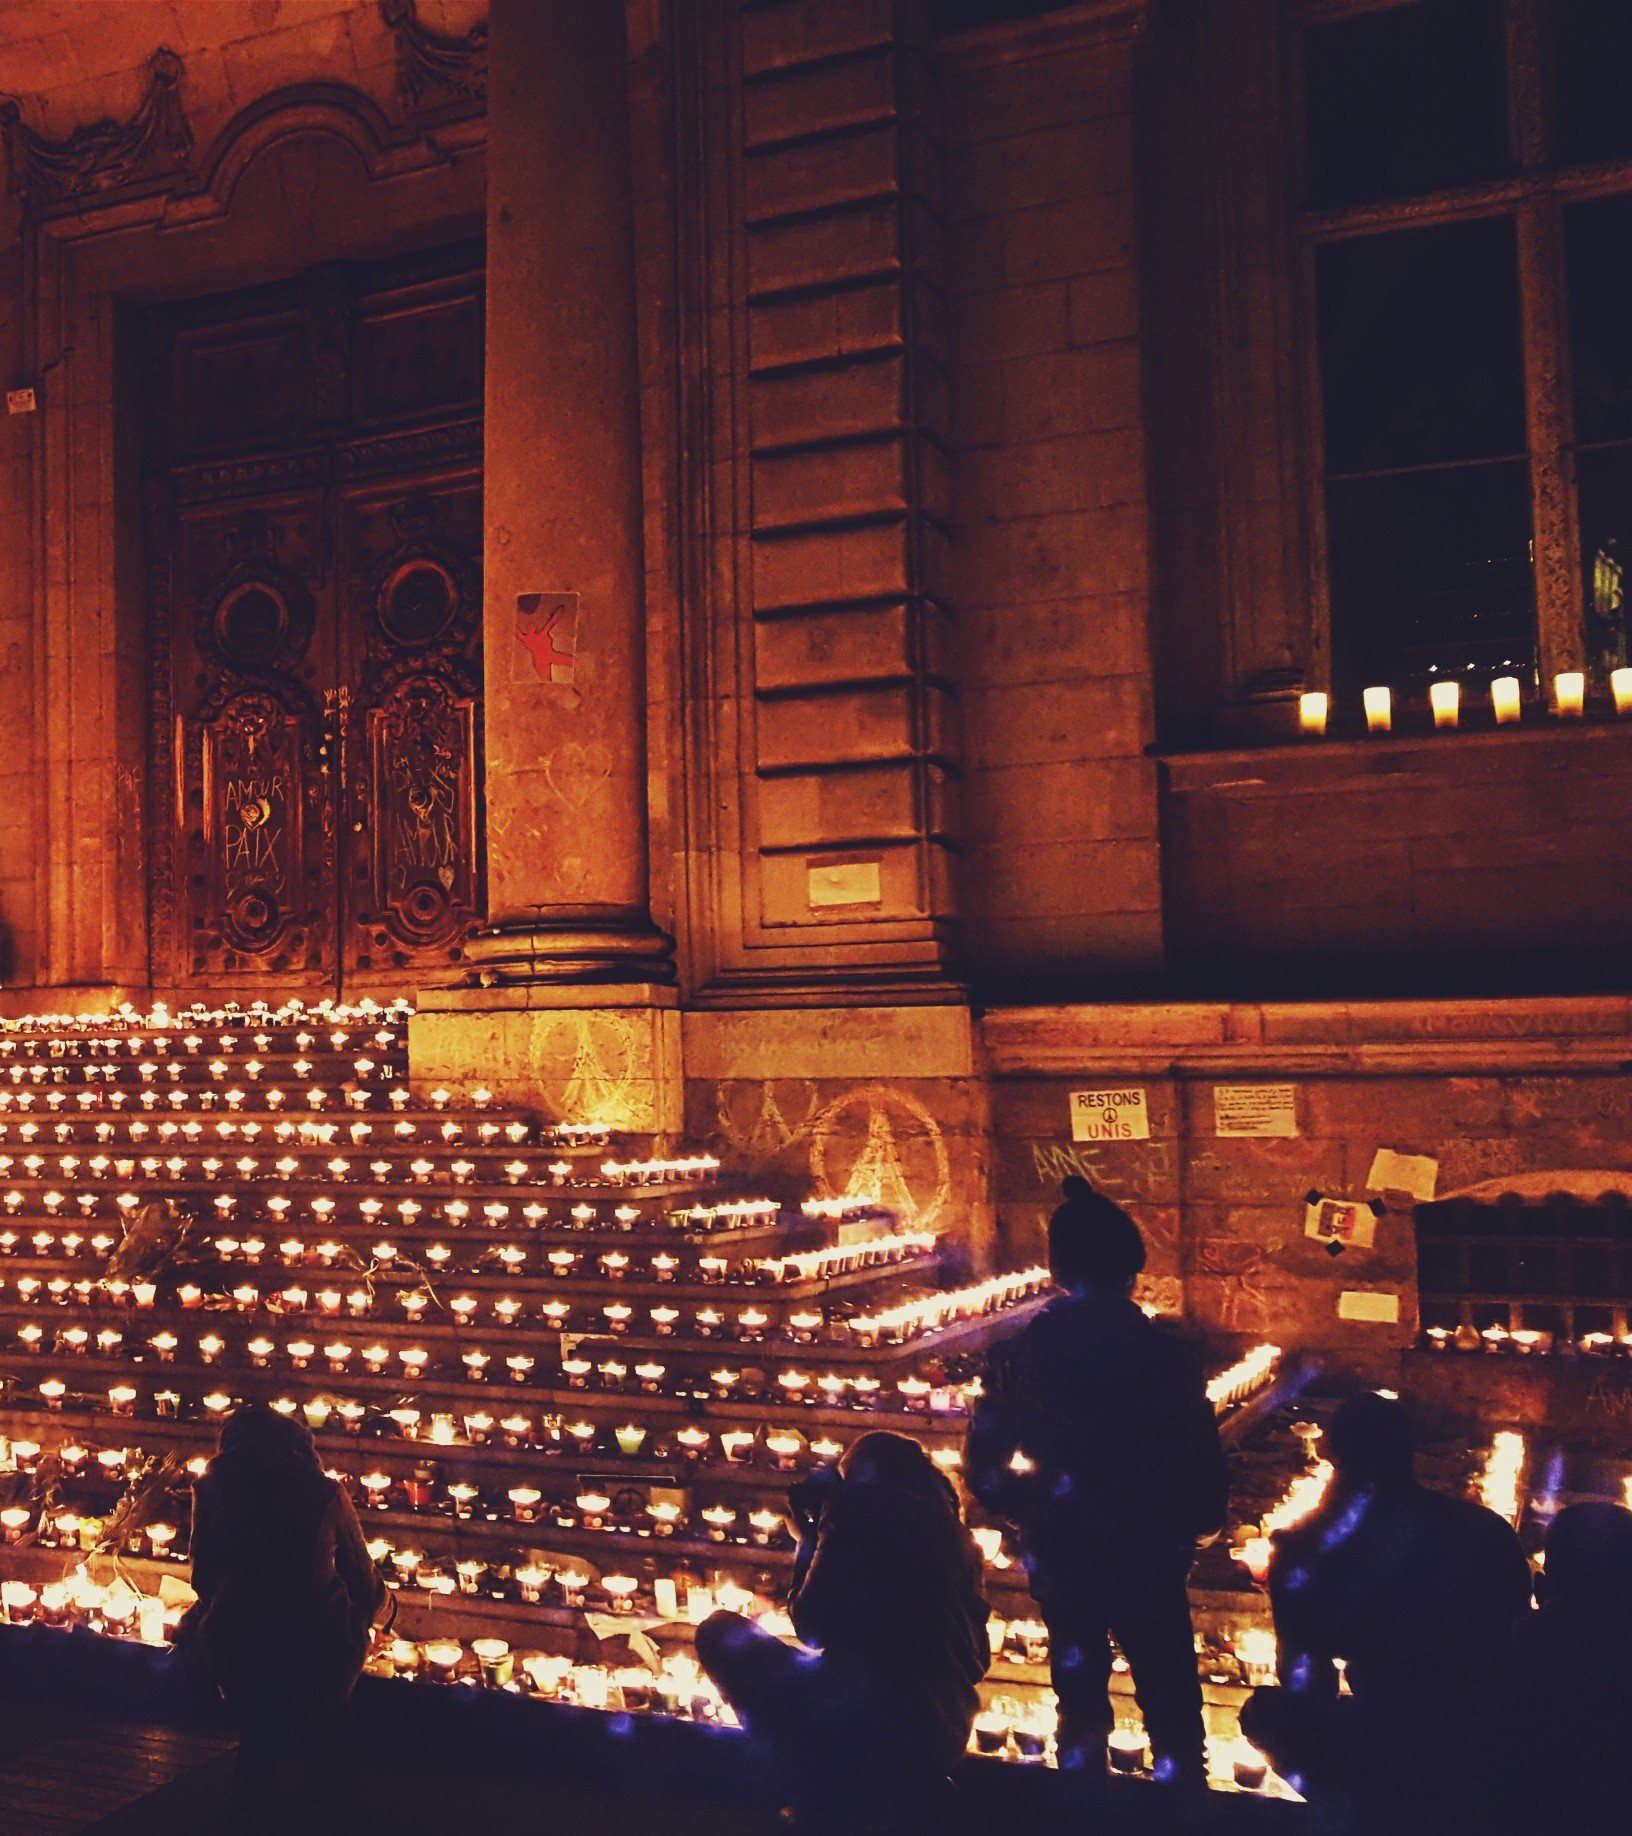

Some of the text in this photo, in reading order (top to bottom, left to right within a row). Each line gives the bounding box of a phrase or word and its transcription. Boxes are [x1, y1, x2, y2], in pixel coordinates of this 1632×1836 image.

[225, 775, 285, 811] AMOUR
[224, 824, 283, 873] PAIX
[1077, 1091, 1141, 1108] RESTONS
[1087, 1123, 1132, 1139] UNIS
